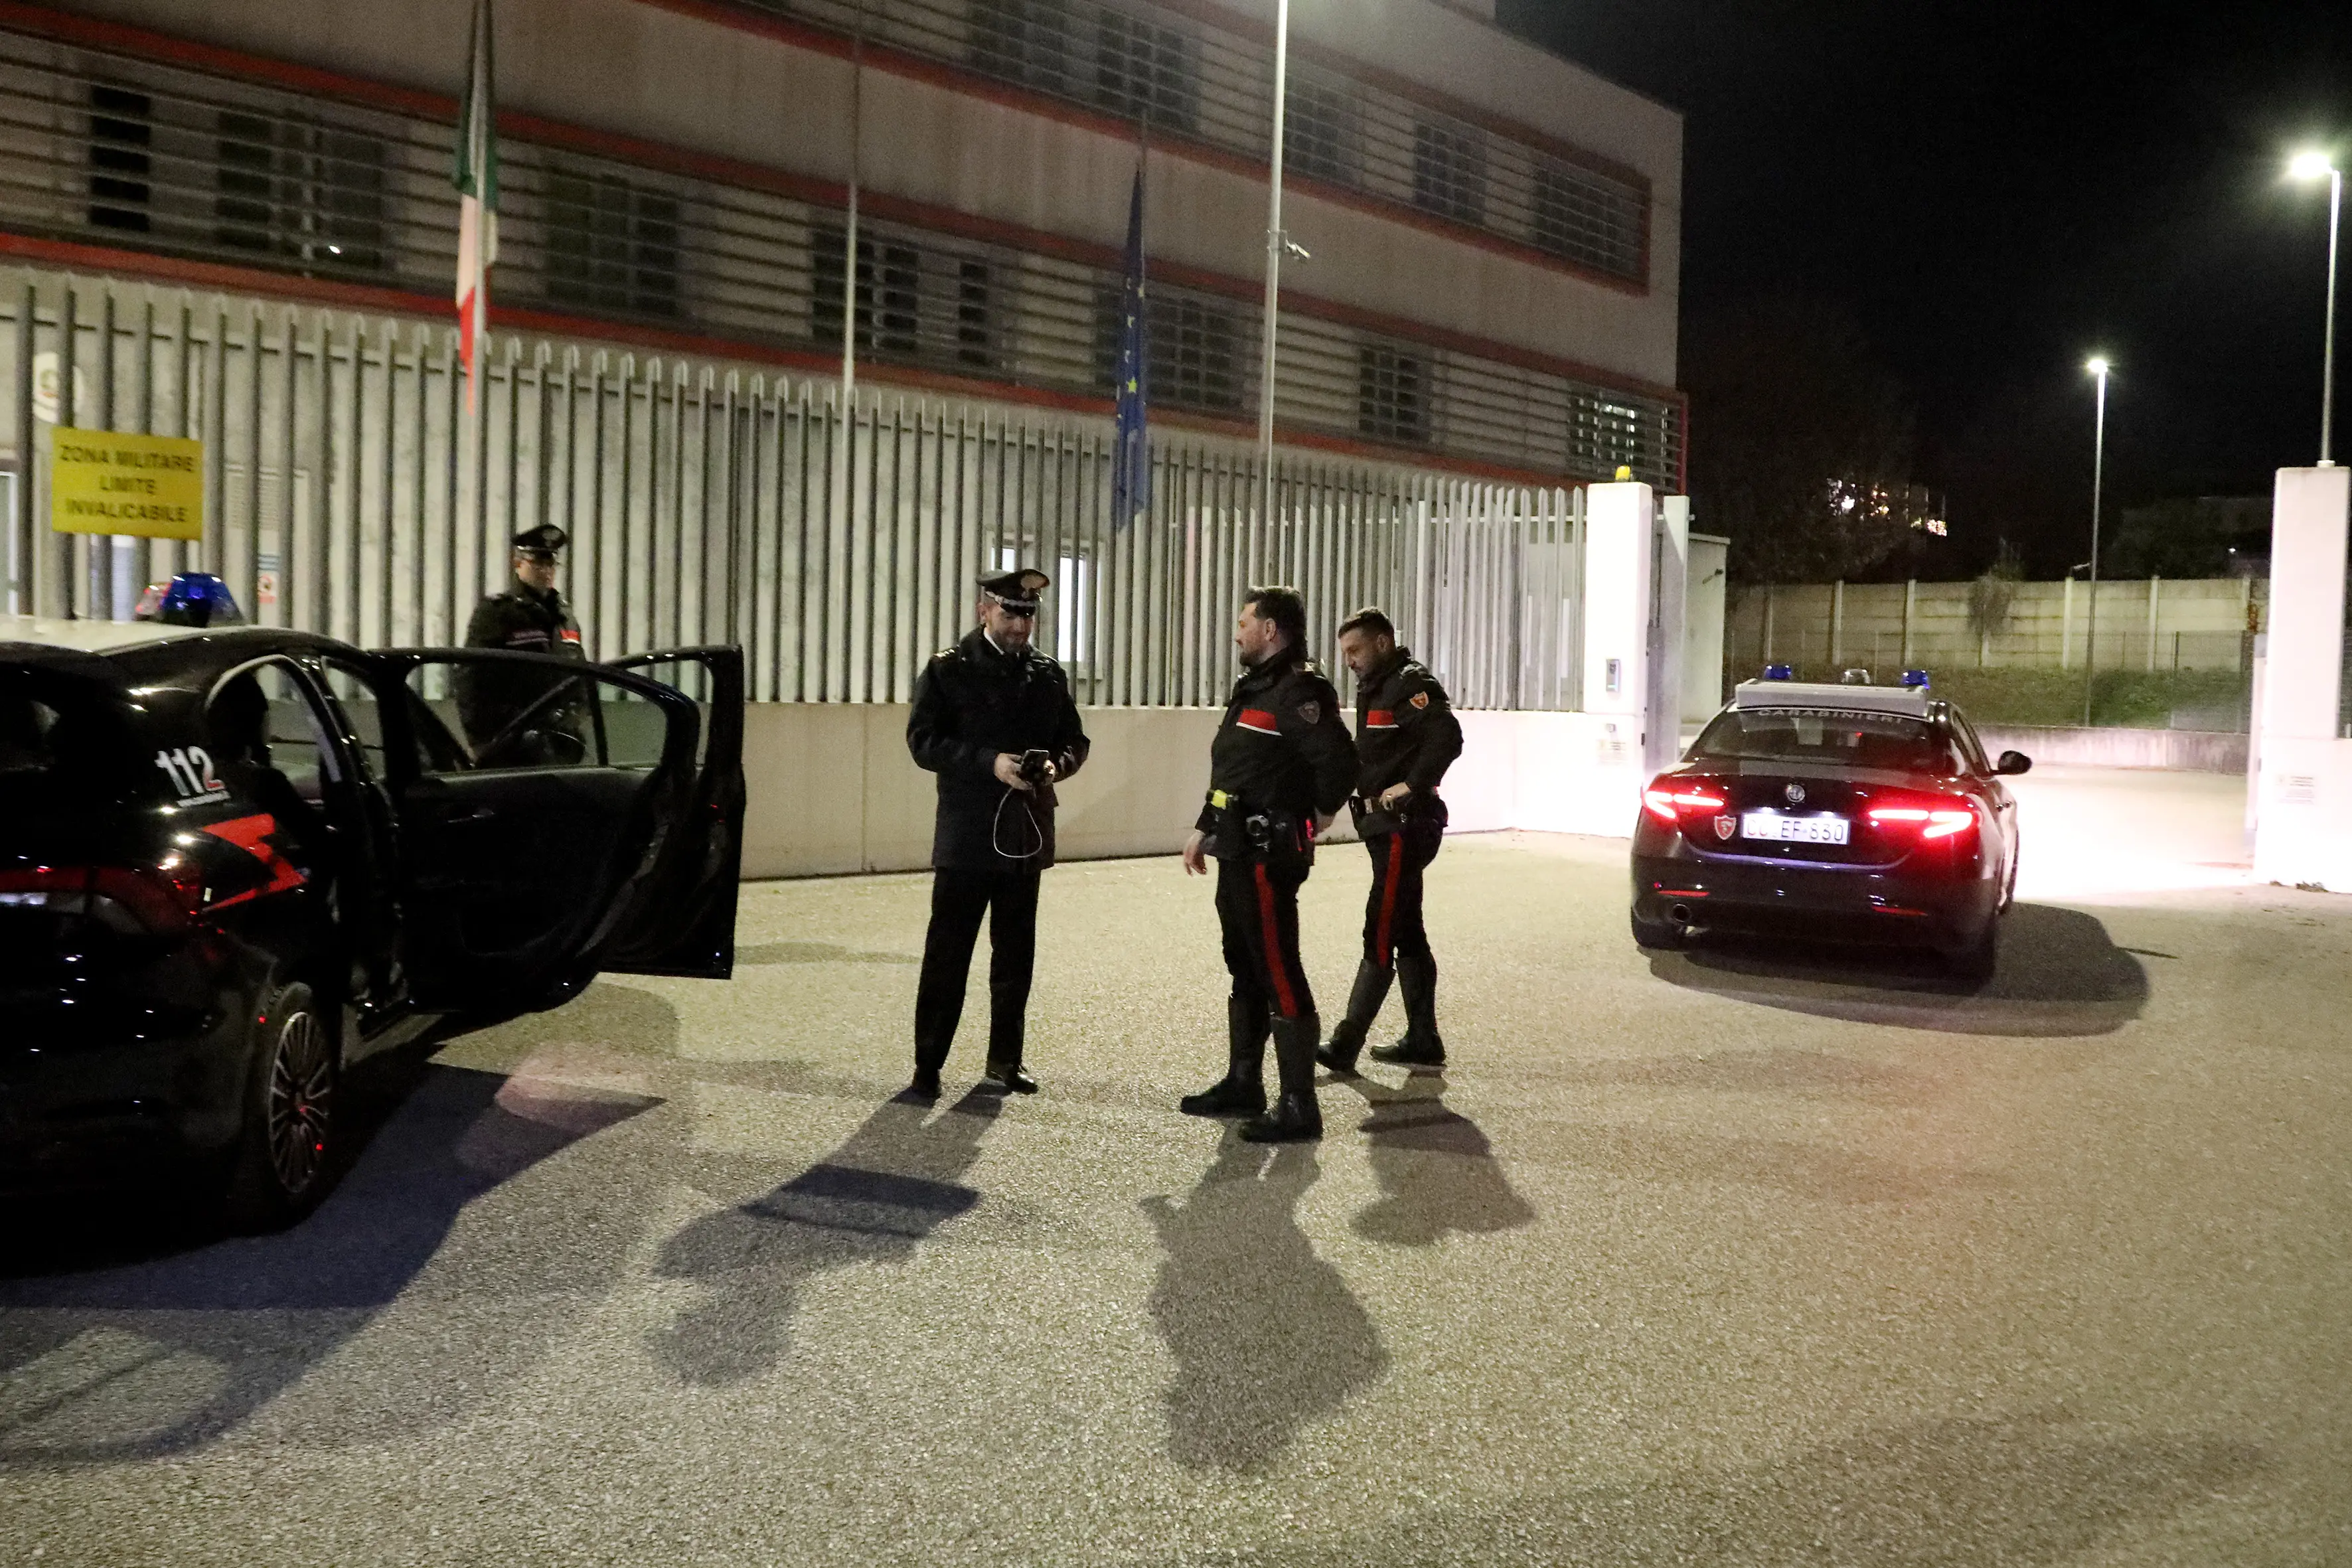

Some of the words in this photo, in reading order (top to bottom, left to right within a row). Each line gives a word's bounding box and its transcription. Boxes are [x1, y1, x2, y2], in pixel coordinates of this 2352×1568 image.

[60, 444, 109, 463] ZONA
[116, 450, 193, 472] MILITARE
[100, 474, 155, 495] LIMITE
[66, 499, 188, 522] INVALICABILE
[1757, 709, 1903, 724] CARABINIERI
[153, 745, 226, 797] 112
